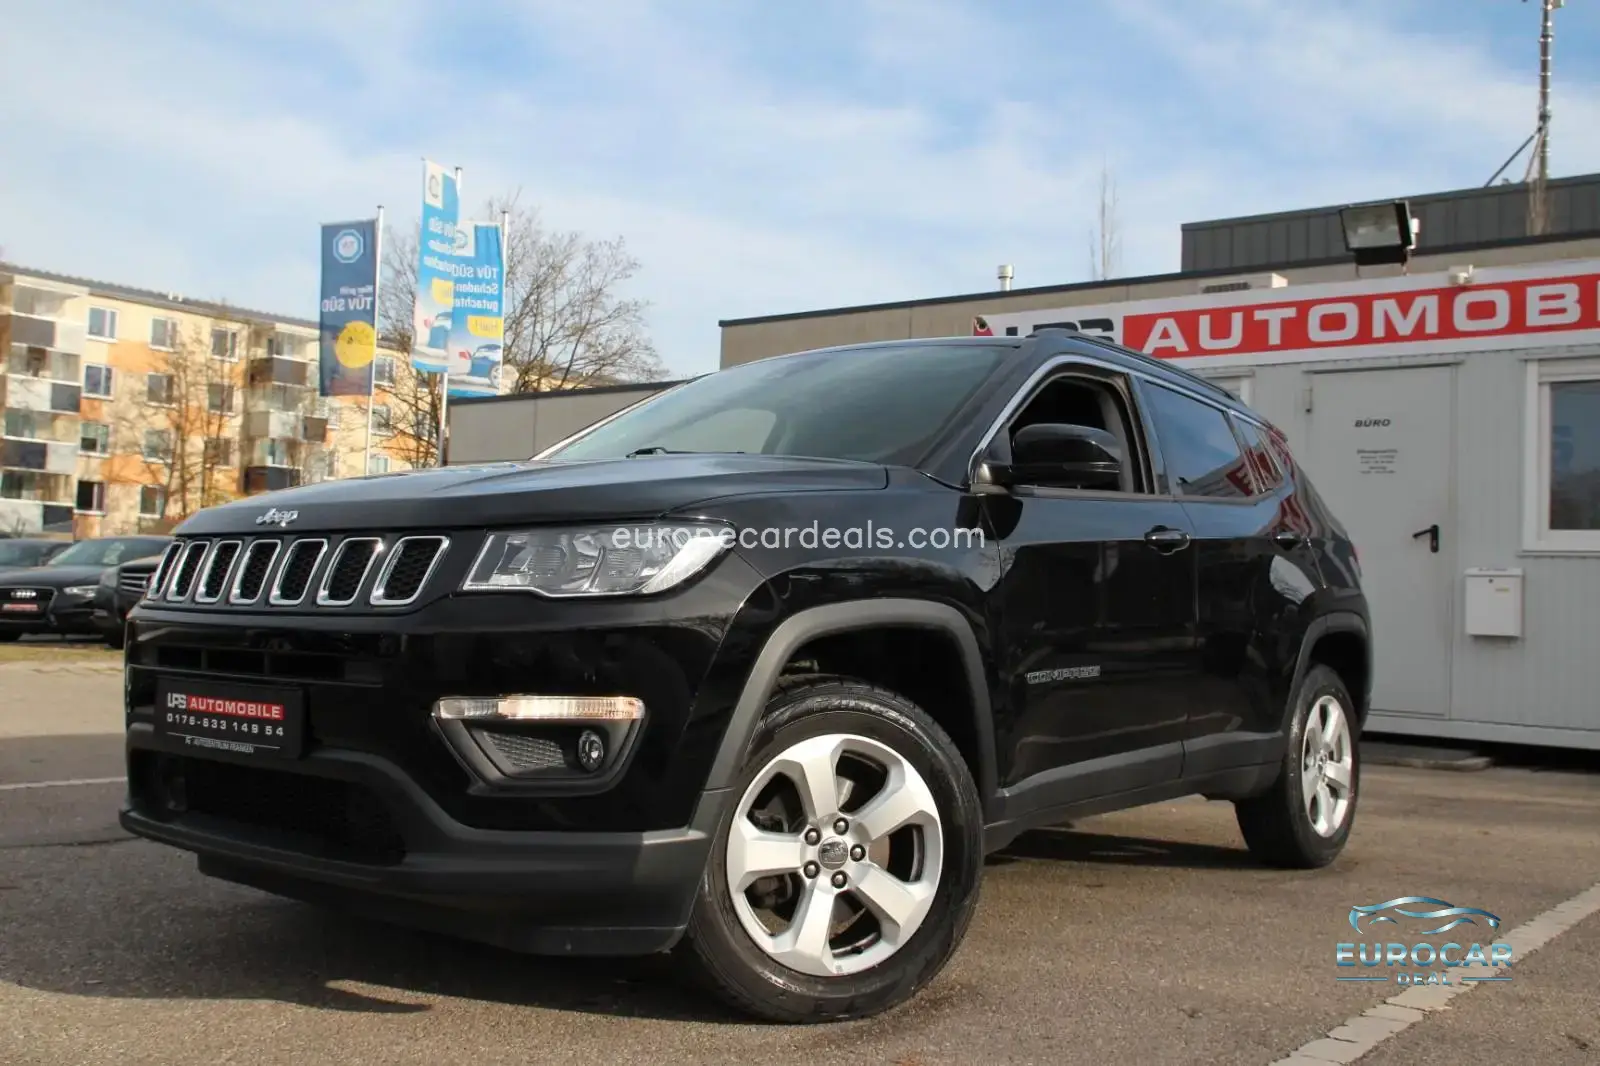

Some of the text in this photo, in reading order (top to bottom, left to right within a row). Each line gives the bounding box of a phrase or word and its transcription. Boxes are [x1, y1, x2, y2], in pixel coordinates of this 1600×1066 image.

[1142, 280, 1600, 355] AUTOMOB
[1354, 417, 1391, 428] BÜRO
[190, 697, 281, 718] AUTOMOBILE
